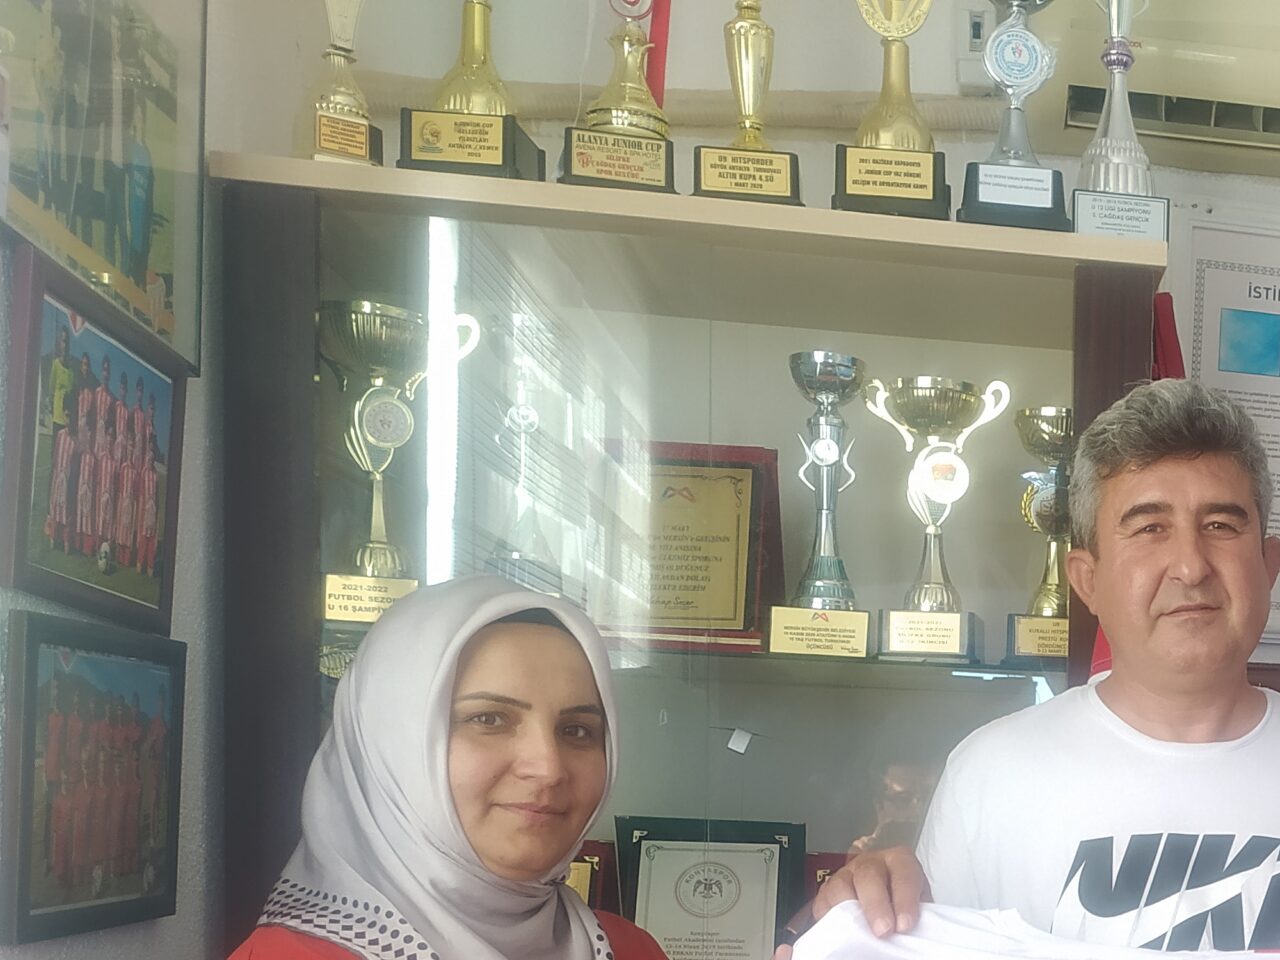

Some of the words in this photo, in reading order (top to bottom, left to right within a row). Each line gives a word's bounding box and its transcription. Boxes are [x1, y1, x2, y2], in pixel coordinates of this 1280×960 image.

[575, 133, 609, 146] ALANYA
[611, 138, 643, 150] JUNIOR
[645, 142, 662, 152] CUP
[718, 172, 737, 180] ALTIN
[739, 173, 756, 181] KUPA
[341, 583, 389, 593] 2021-2022
[328, 593, 366, 602] FUTBOL
